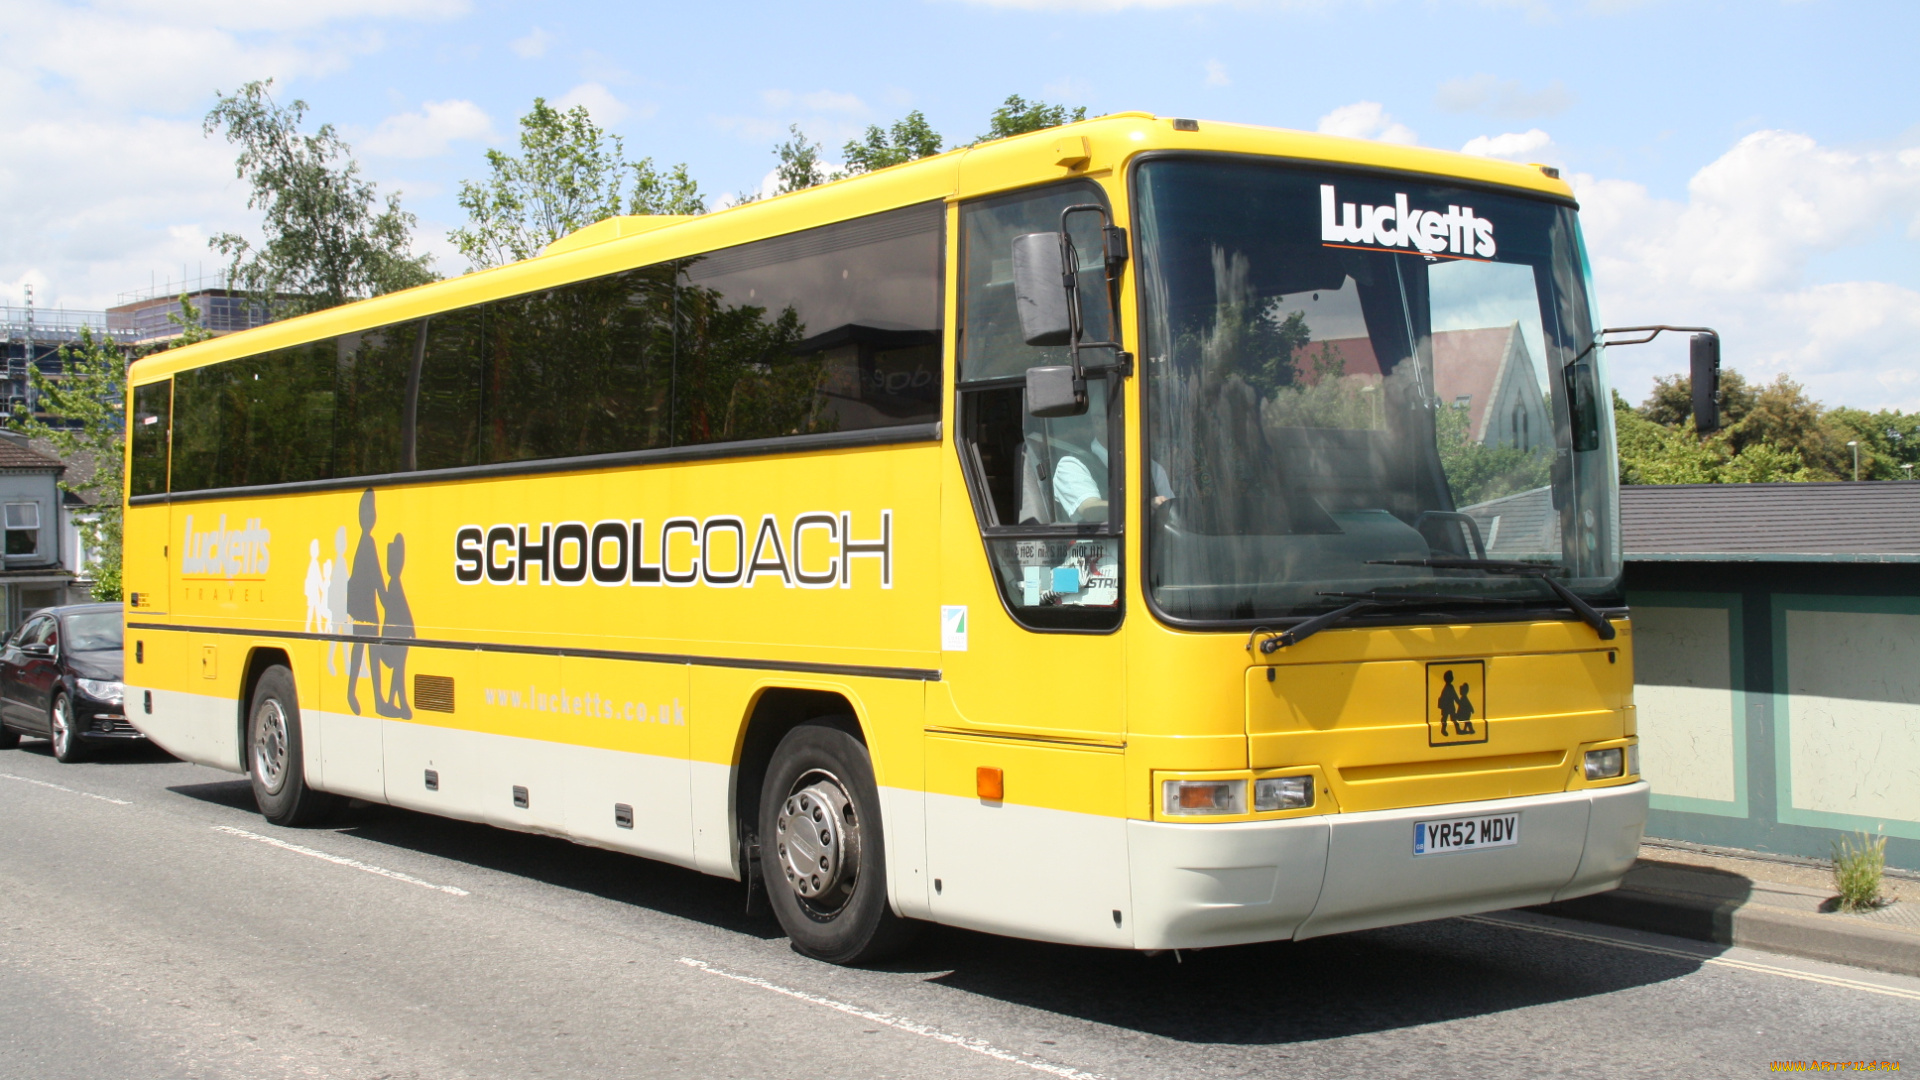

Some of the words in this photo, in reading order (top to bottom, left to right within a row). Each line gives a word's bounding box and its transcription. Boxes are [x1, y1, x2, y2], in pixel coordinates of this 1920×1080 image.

[1320, 184, 1496, 258] Lucketts
[182, 513, 270, 577] Lucketts
[455, 509, 893, 589] SCHOOLCOACH
[185, 587, 265, 602] TRAVEL
[484, 685, 686, 726] www.lucketts.co.uk
[1428, 821, 1475, 848] YR52
[1481, 817, 1515, 843] MDV
